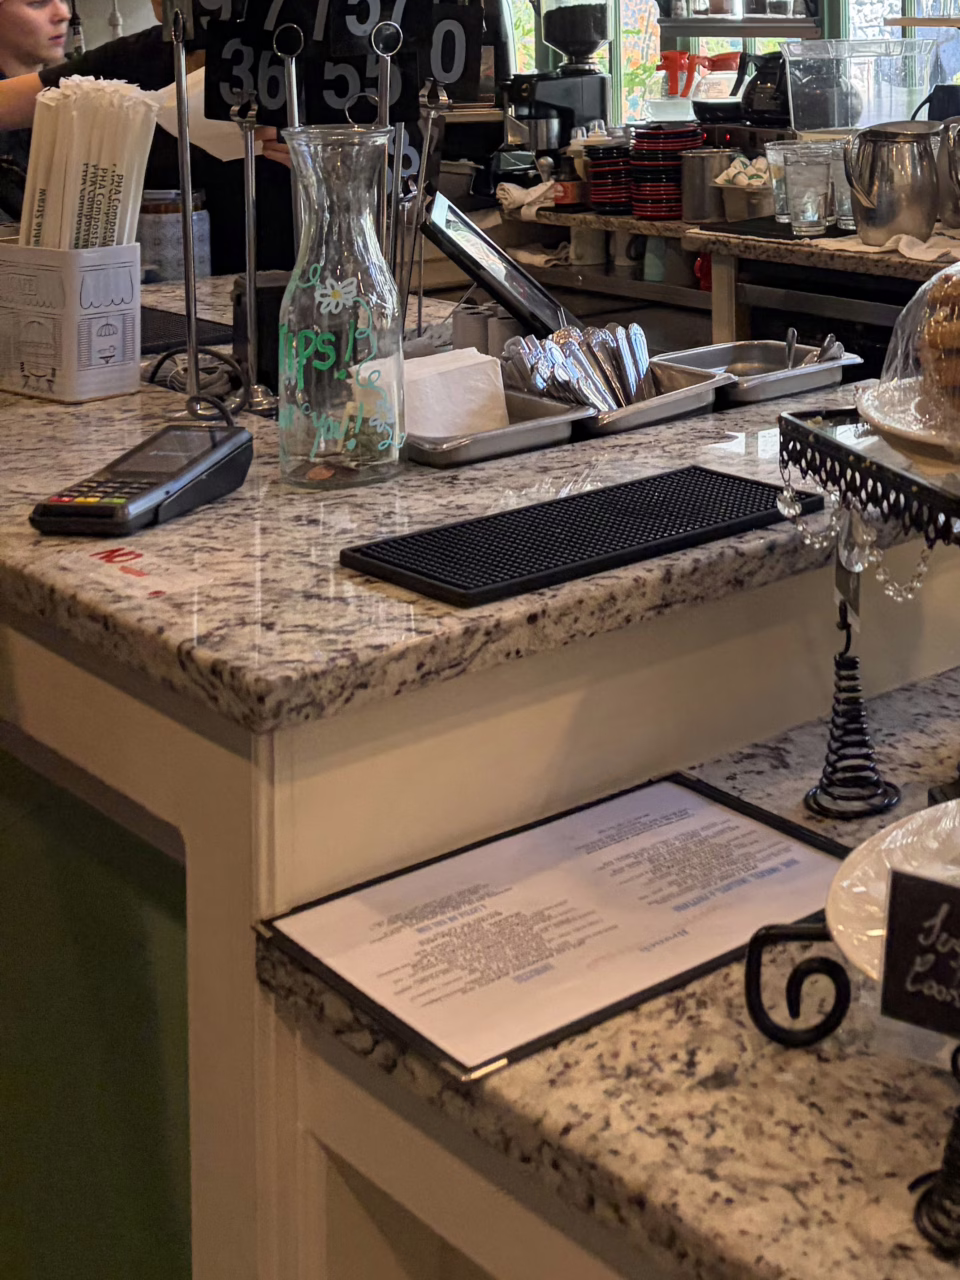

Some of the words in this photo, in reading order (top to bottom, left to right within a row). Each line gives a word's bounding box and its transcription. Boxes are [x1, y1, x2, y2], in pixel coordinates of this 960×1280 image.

[98, 167, 108, 190] PHA
[114, 173, 124, 196] PHA
[34, 187, 47, 220] Straw
[90, 192, 105, 248] Composta
